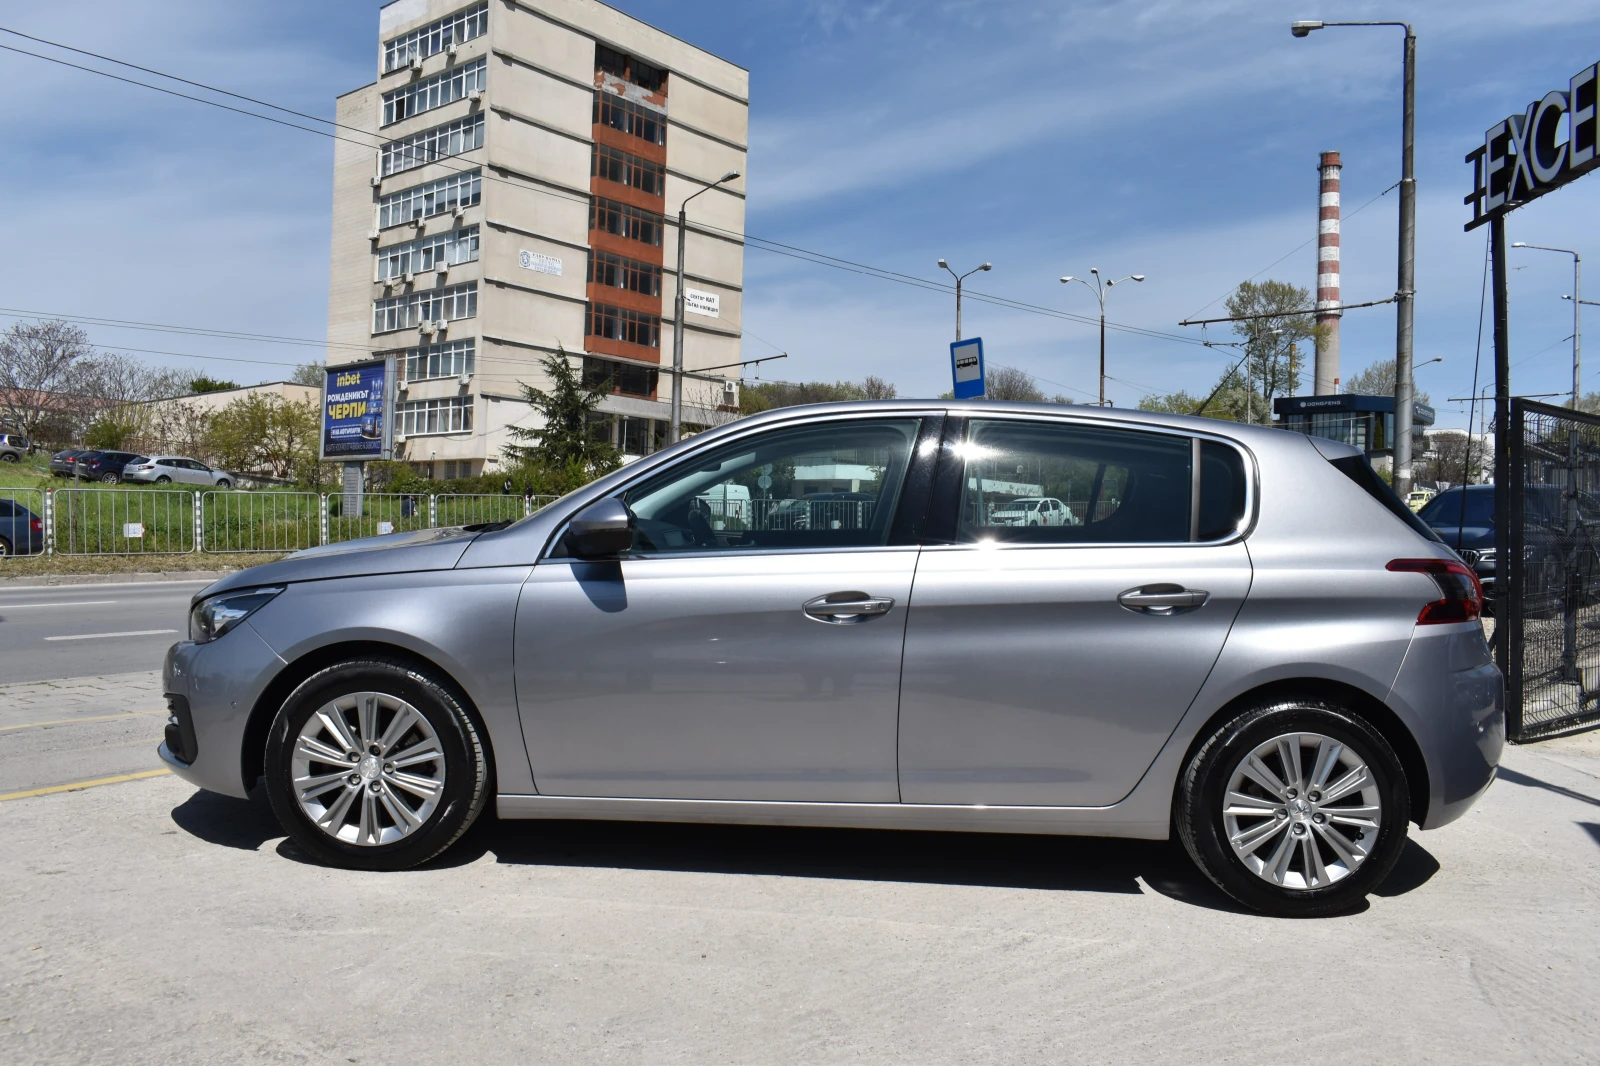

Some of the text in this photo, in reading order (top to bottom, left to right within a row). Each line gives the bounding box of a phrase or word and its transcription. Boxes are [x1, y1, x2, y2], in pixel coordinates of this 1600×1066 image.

[1485, 60, 1600, 214] EXCE
[705, 296, 715, 304] КАТ
[336, 372, 361, 387] inbet
[327, 390, 369, 403] РОЖДЕНИКЪТ
[328, 401, 367, 419] ЧЕРПИ
